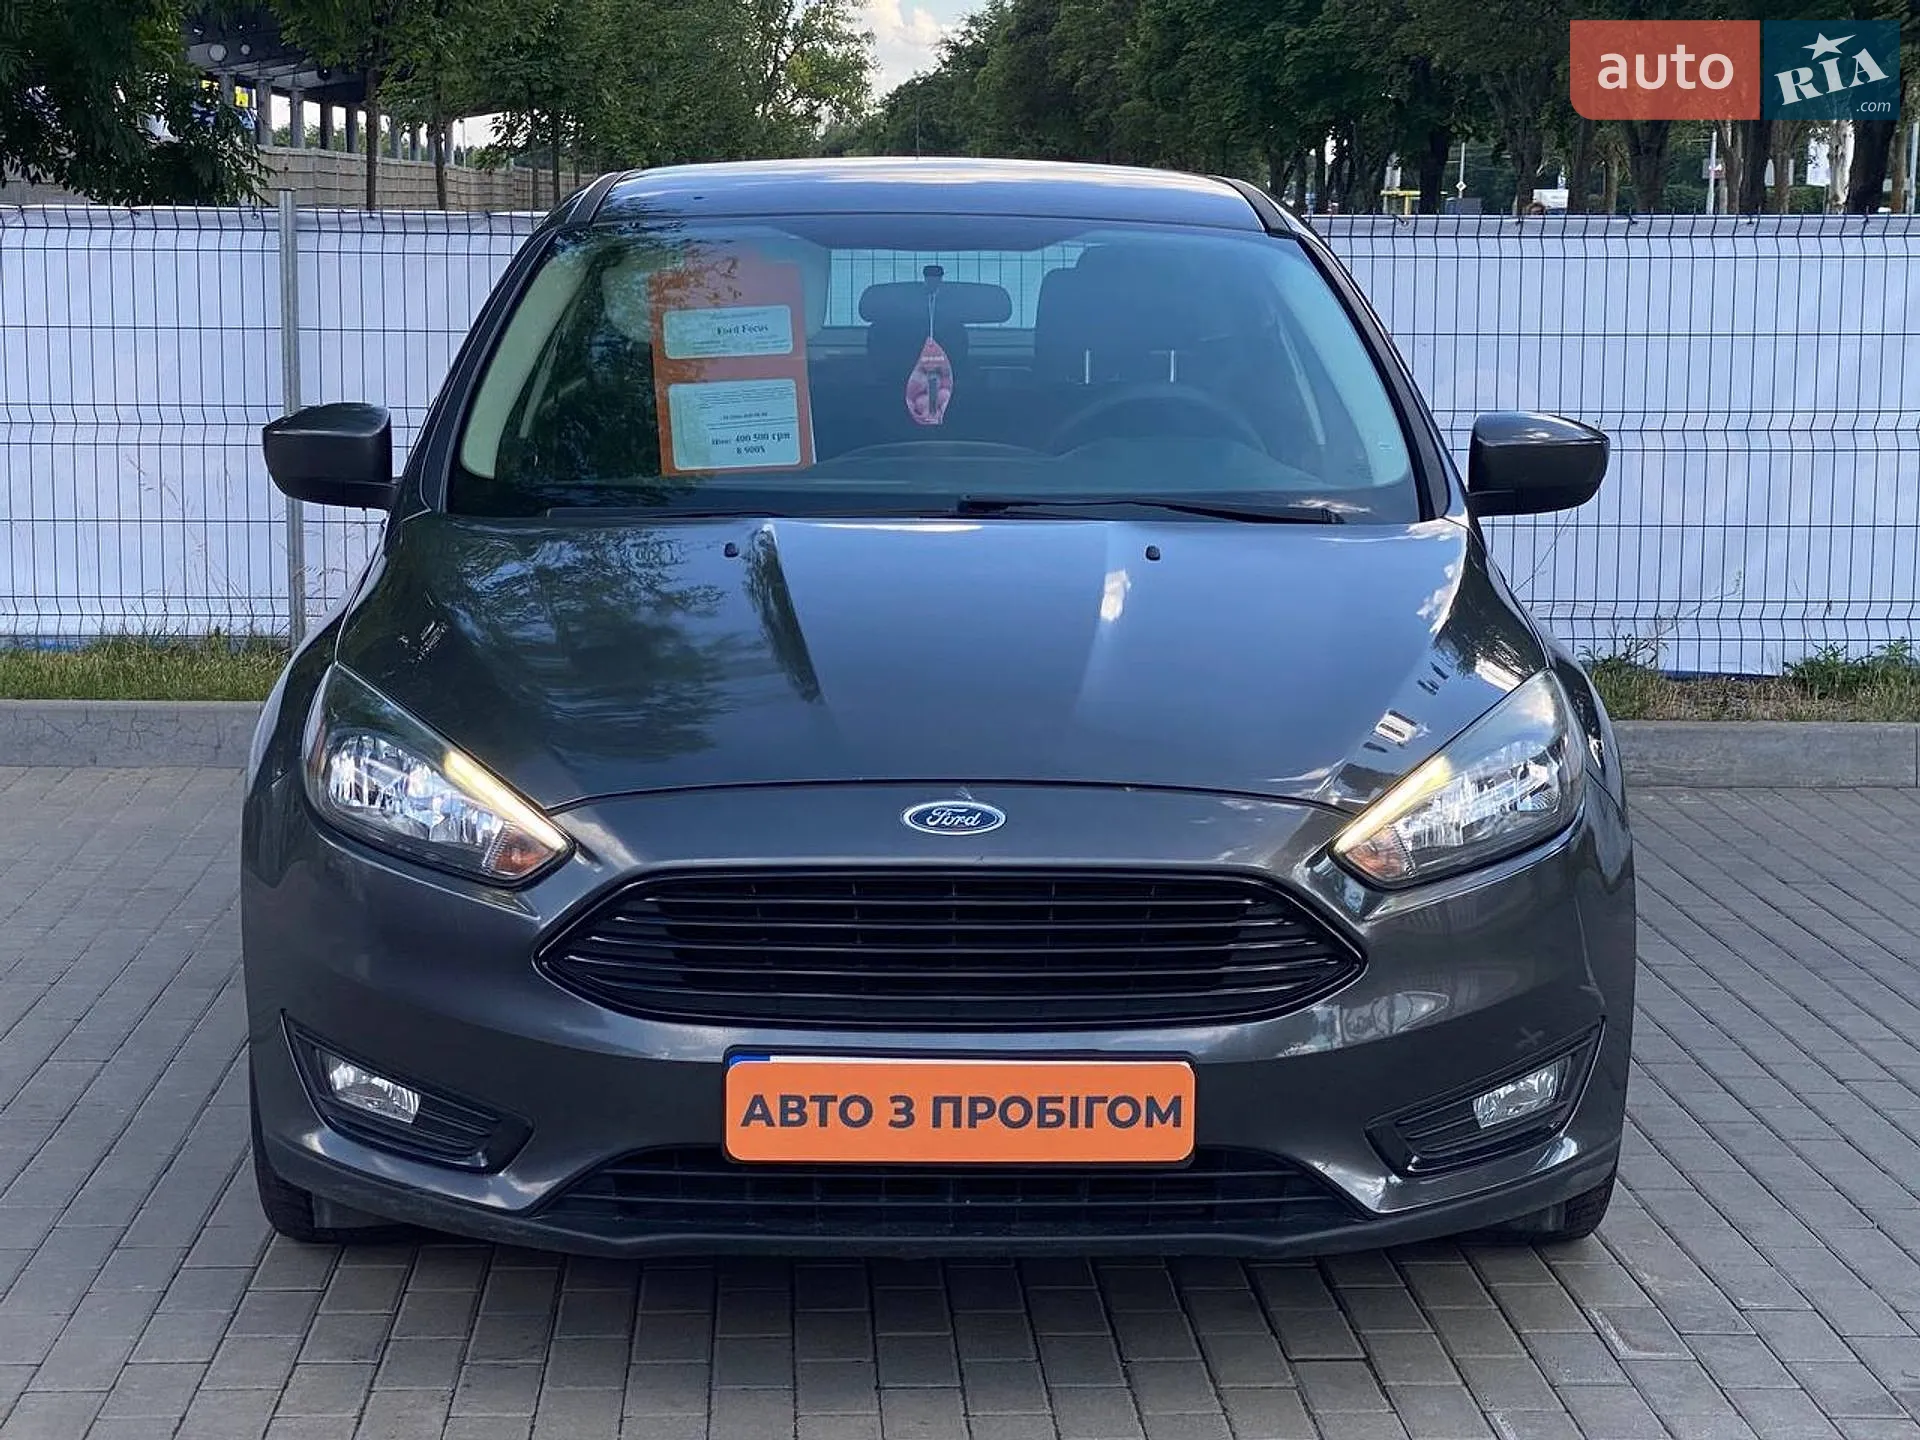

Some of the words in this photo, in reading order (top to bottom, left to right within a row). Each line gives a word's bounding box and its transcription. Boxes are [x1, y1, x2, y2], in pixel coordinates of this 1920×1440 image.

[926, 807, 981, 826] Ford
[741, 1093, 873, 1128] АВТО
[888, 1095, 915, 1129] З
[932, 1094, 1182, 1129] ПРОБІГОМ
